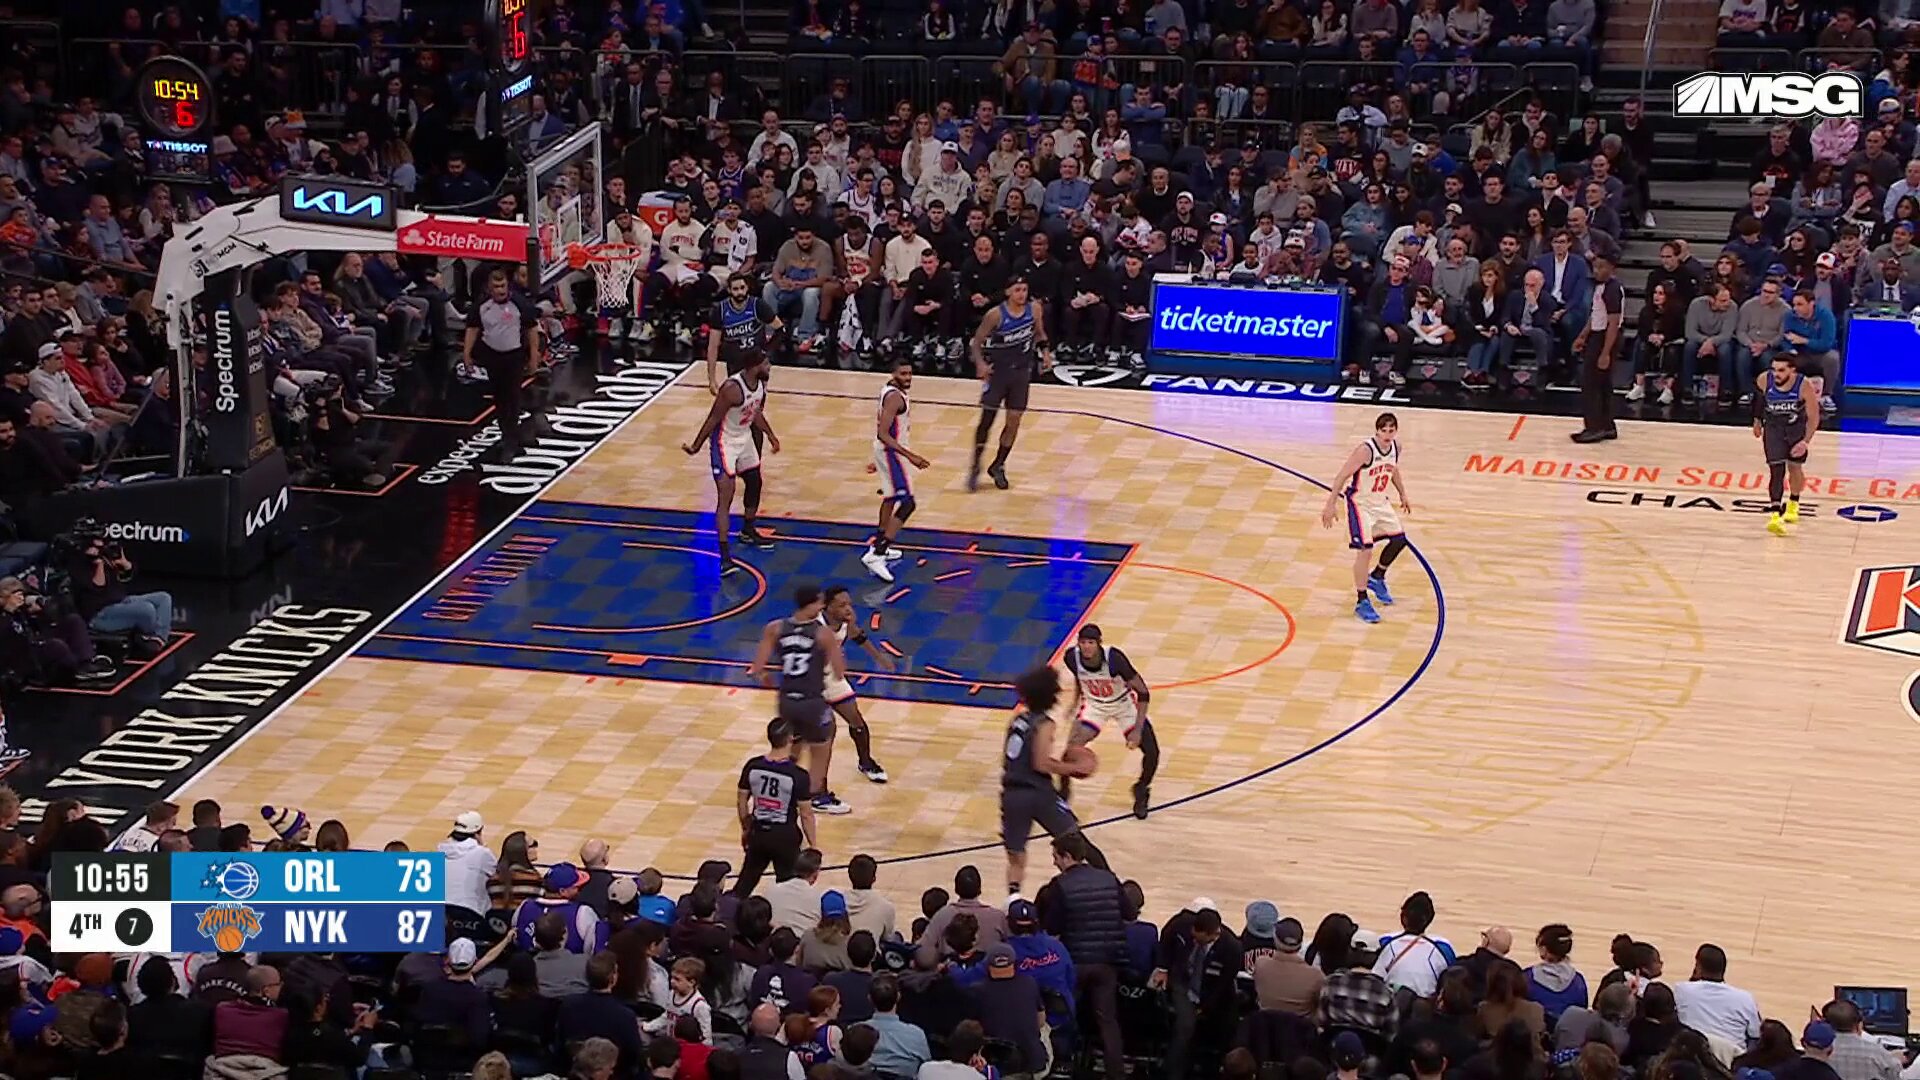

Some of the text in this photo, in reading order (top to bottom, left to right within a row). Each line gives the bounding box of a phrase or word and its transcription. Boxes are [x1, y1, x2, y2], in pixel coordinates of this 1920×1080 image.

[513, 11, 527, 59] 6
[154, 79, 199, 101] 10:54
[176, 101, 195, 127] 6
[163, 141, 208, 154] TISSOT
[654, 210, 669, 225] G
[725, 321, 755, 337] MAGIC
[1160, 305, 1332, 339] ticketmaster
[739, 337, 755, 349] 35
[214, 310, 240, 412] Spectrum
[1140, 373, 1412, 403] FANDUEL
[1371, 474, 1389, 493] 13
[1463, 454, 1661, 482] MADISON
[1676, 466, 1853, 497] SQURE
[1587, 490, 1819, 518] CHASE
[103, 521, 183, 543] ectrum
[782, 652, 812, 676] 13
[46, 603, 373, 790] YORK KNICKS
[760, 775, 780, 797] 78
